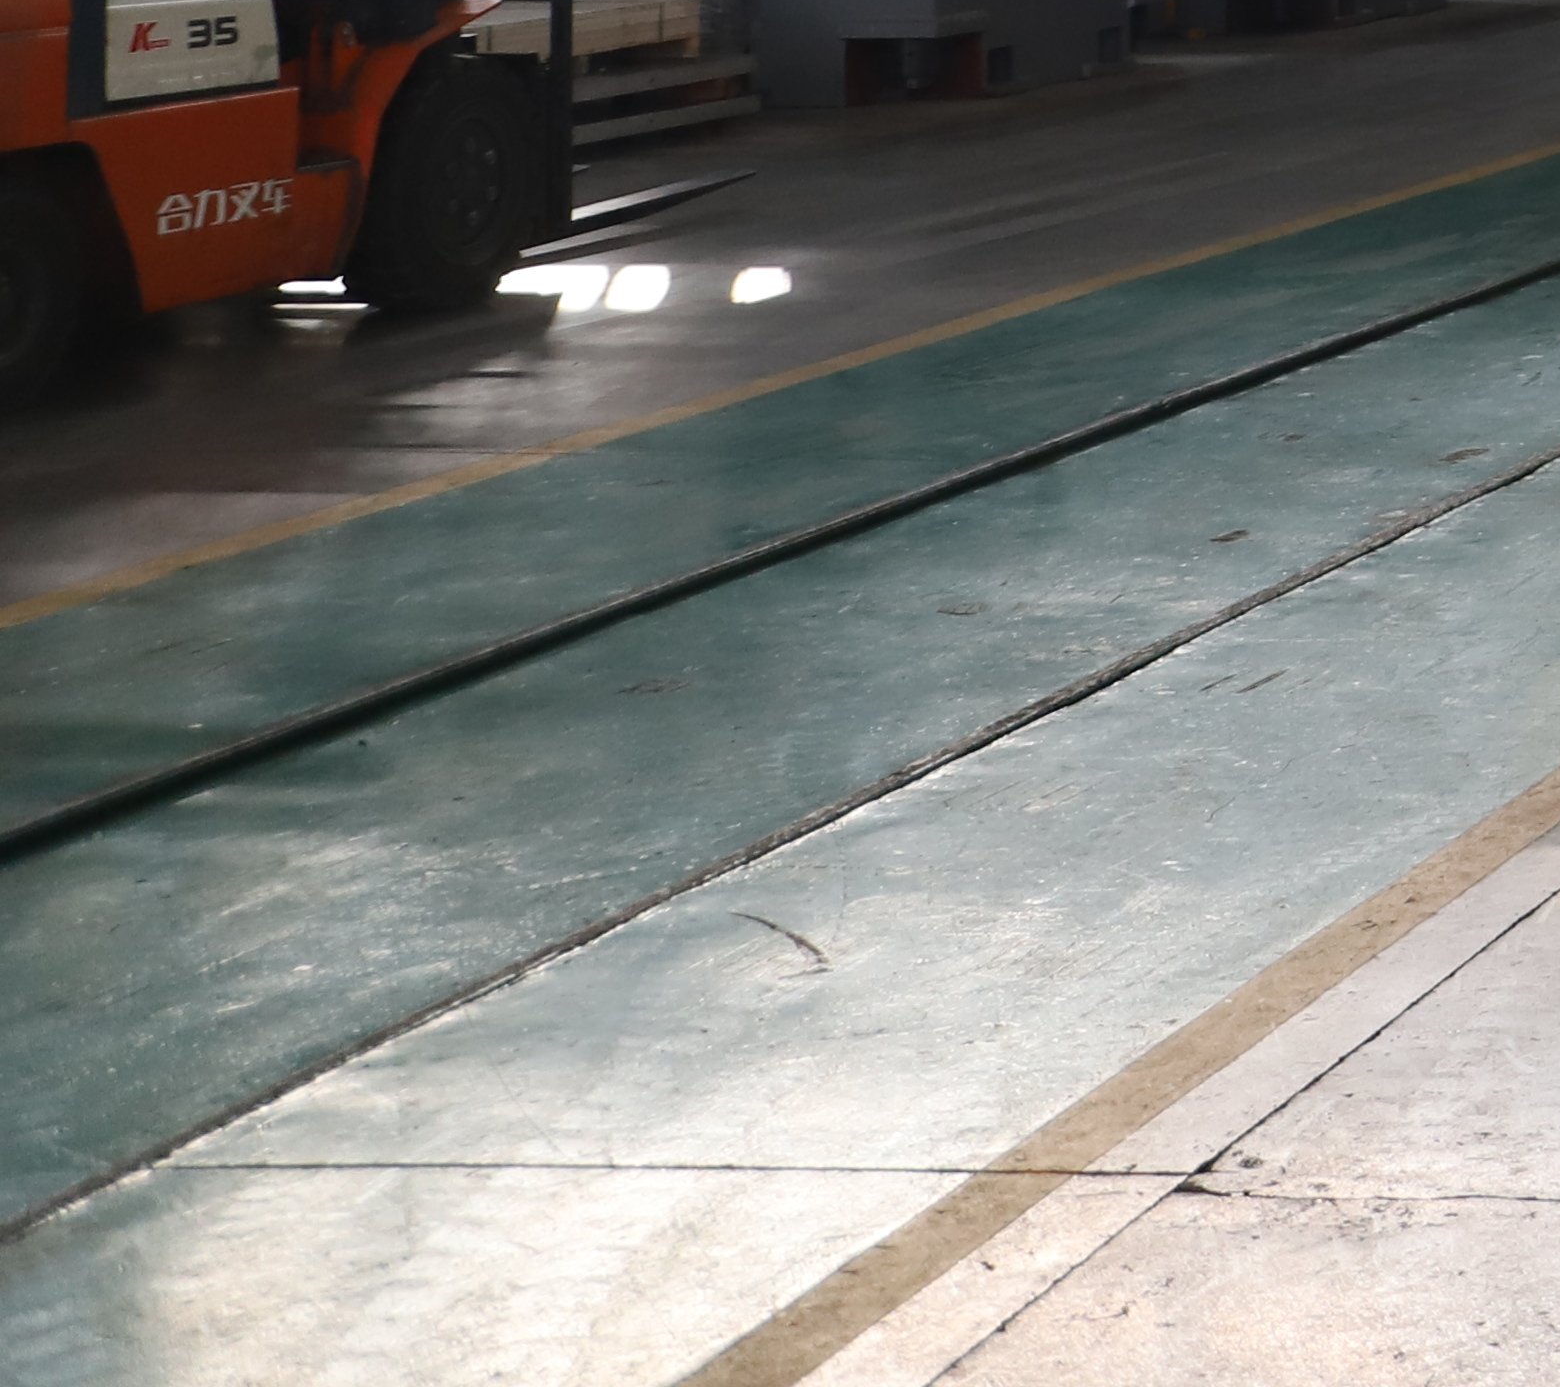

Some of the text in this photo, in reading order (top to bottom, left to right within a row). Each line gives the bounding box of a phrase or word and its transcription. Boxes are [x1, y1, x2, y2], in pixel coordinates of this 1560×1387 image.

[186, 14, 240, 50] 35
[155, 177, 294, 237] 合力叉车
